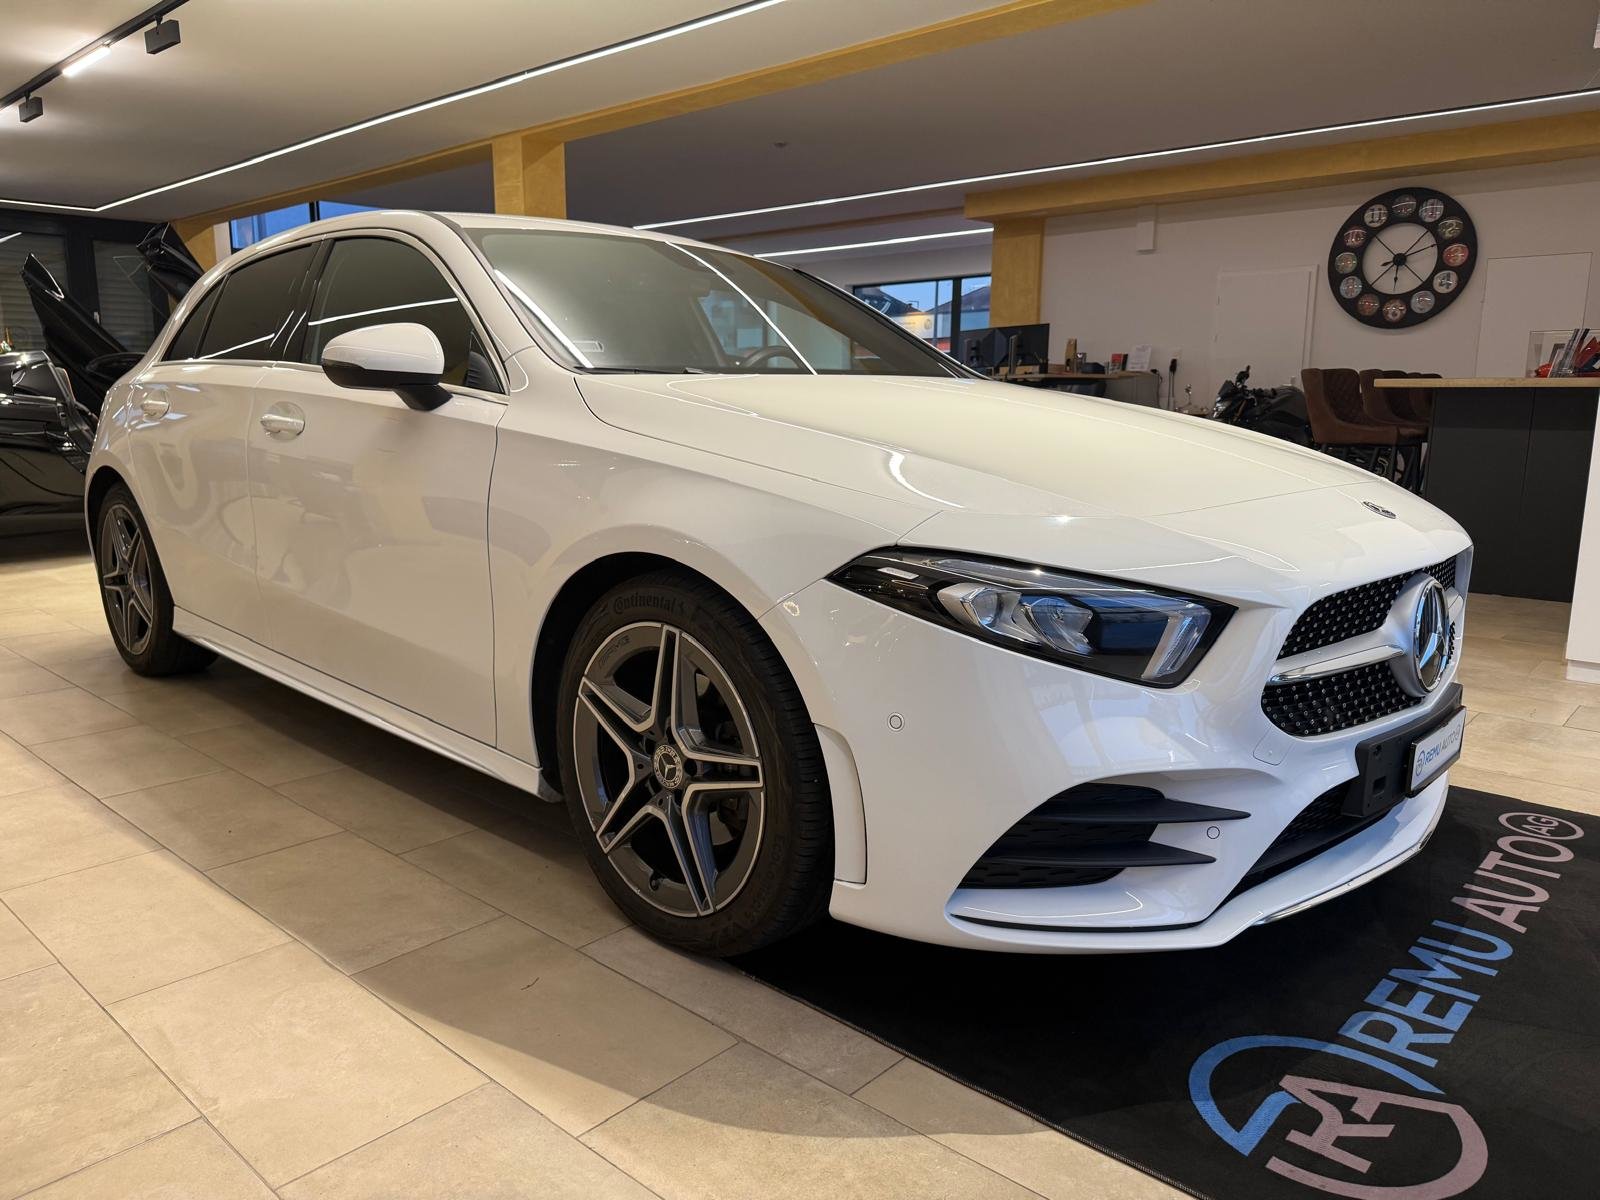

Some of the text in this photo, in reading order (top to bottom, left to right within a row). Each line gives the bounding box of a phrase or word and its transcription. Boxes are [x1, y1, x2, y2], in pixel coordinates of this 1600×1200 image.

[614, 592, 676, 614] Continental
[1425, 744, 1441, 764] REMU
[1337, 815, 1574, 1068] REMU AUTO AG
